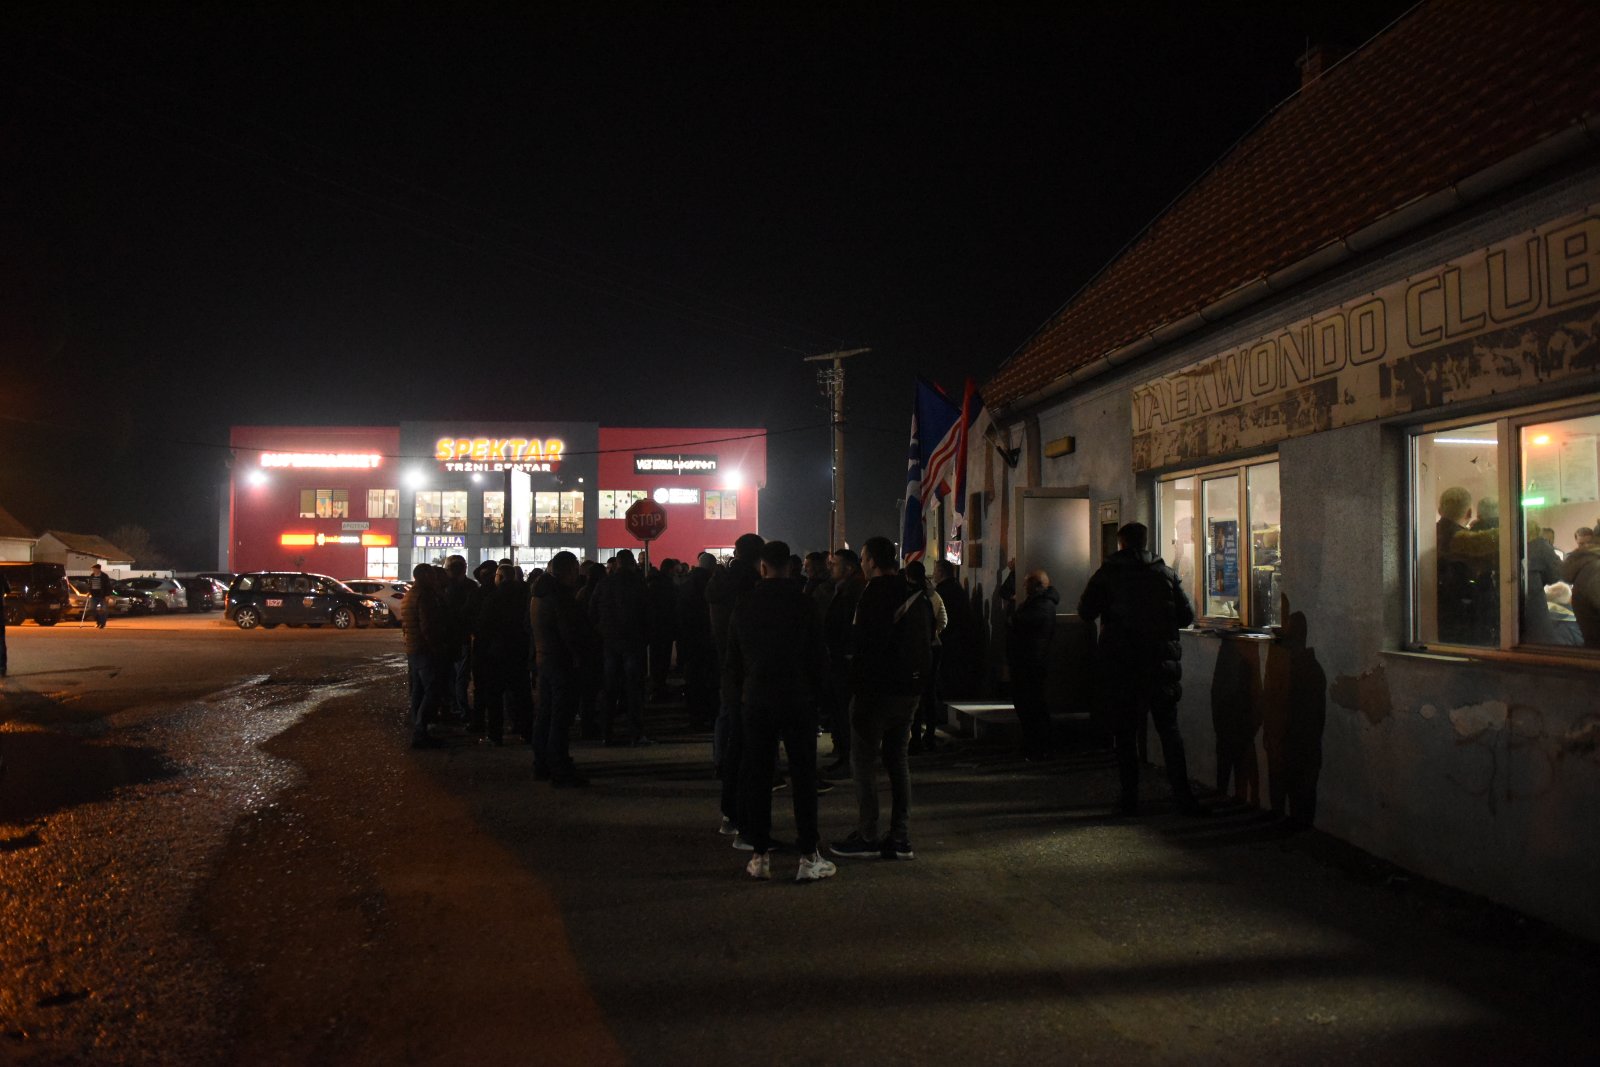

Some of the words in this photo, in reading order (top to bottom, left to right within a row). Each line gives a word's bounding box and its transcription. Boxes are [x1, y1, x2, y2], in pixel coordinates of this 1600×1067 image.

[1132, 297, 1387, 432] TAEKWONDO
[1404, 215, 1600, 349] CLUB
[434, 437, 564, 461] SPEKTAR
[631, 513, 662, 528] STOP
